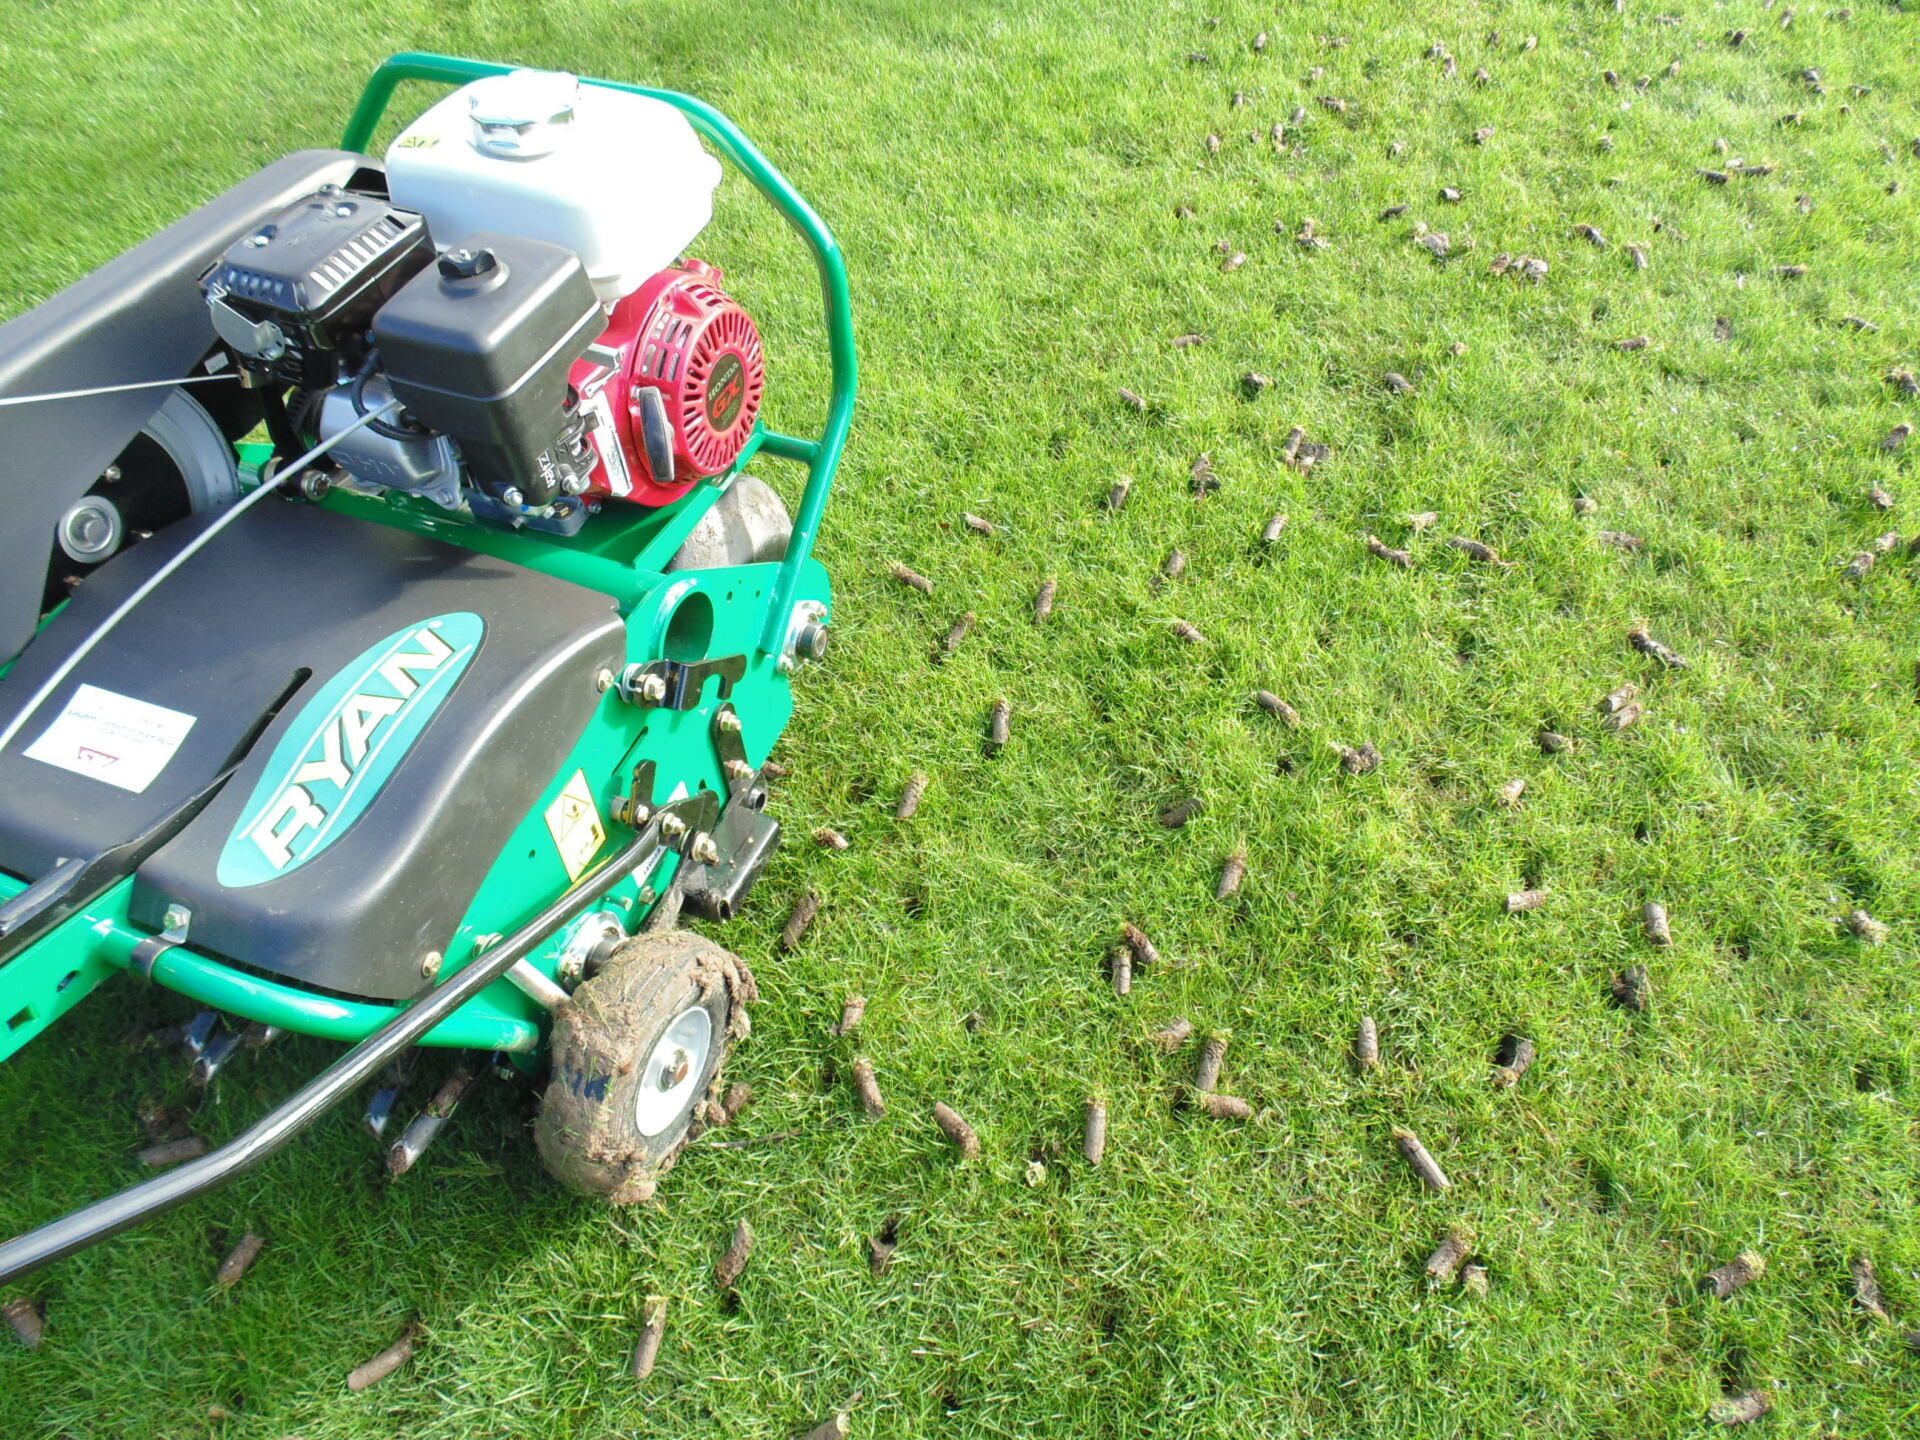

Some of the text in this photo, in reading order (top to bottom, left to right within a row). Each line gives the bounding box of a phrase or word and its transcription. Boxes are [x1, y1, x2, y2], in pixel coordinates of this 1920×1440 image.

[708, 361, 739, 401] HONDA
[712, 372, 741, 419] GX
[250, 627, 456, 871] RYAN
